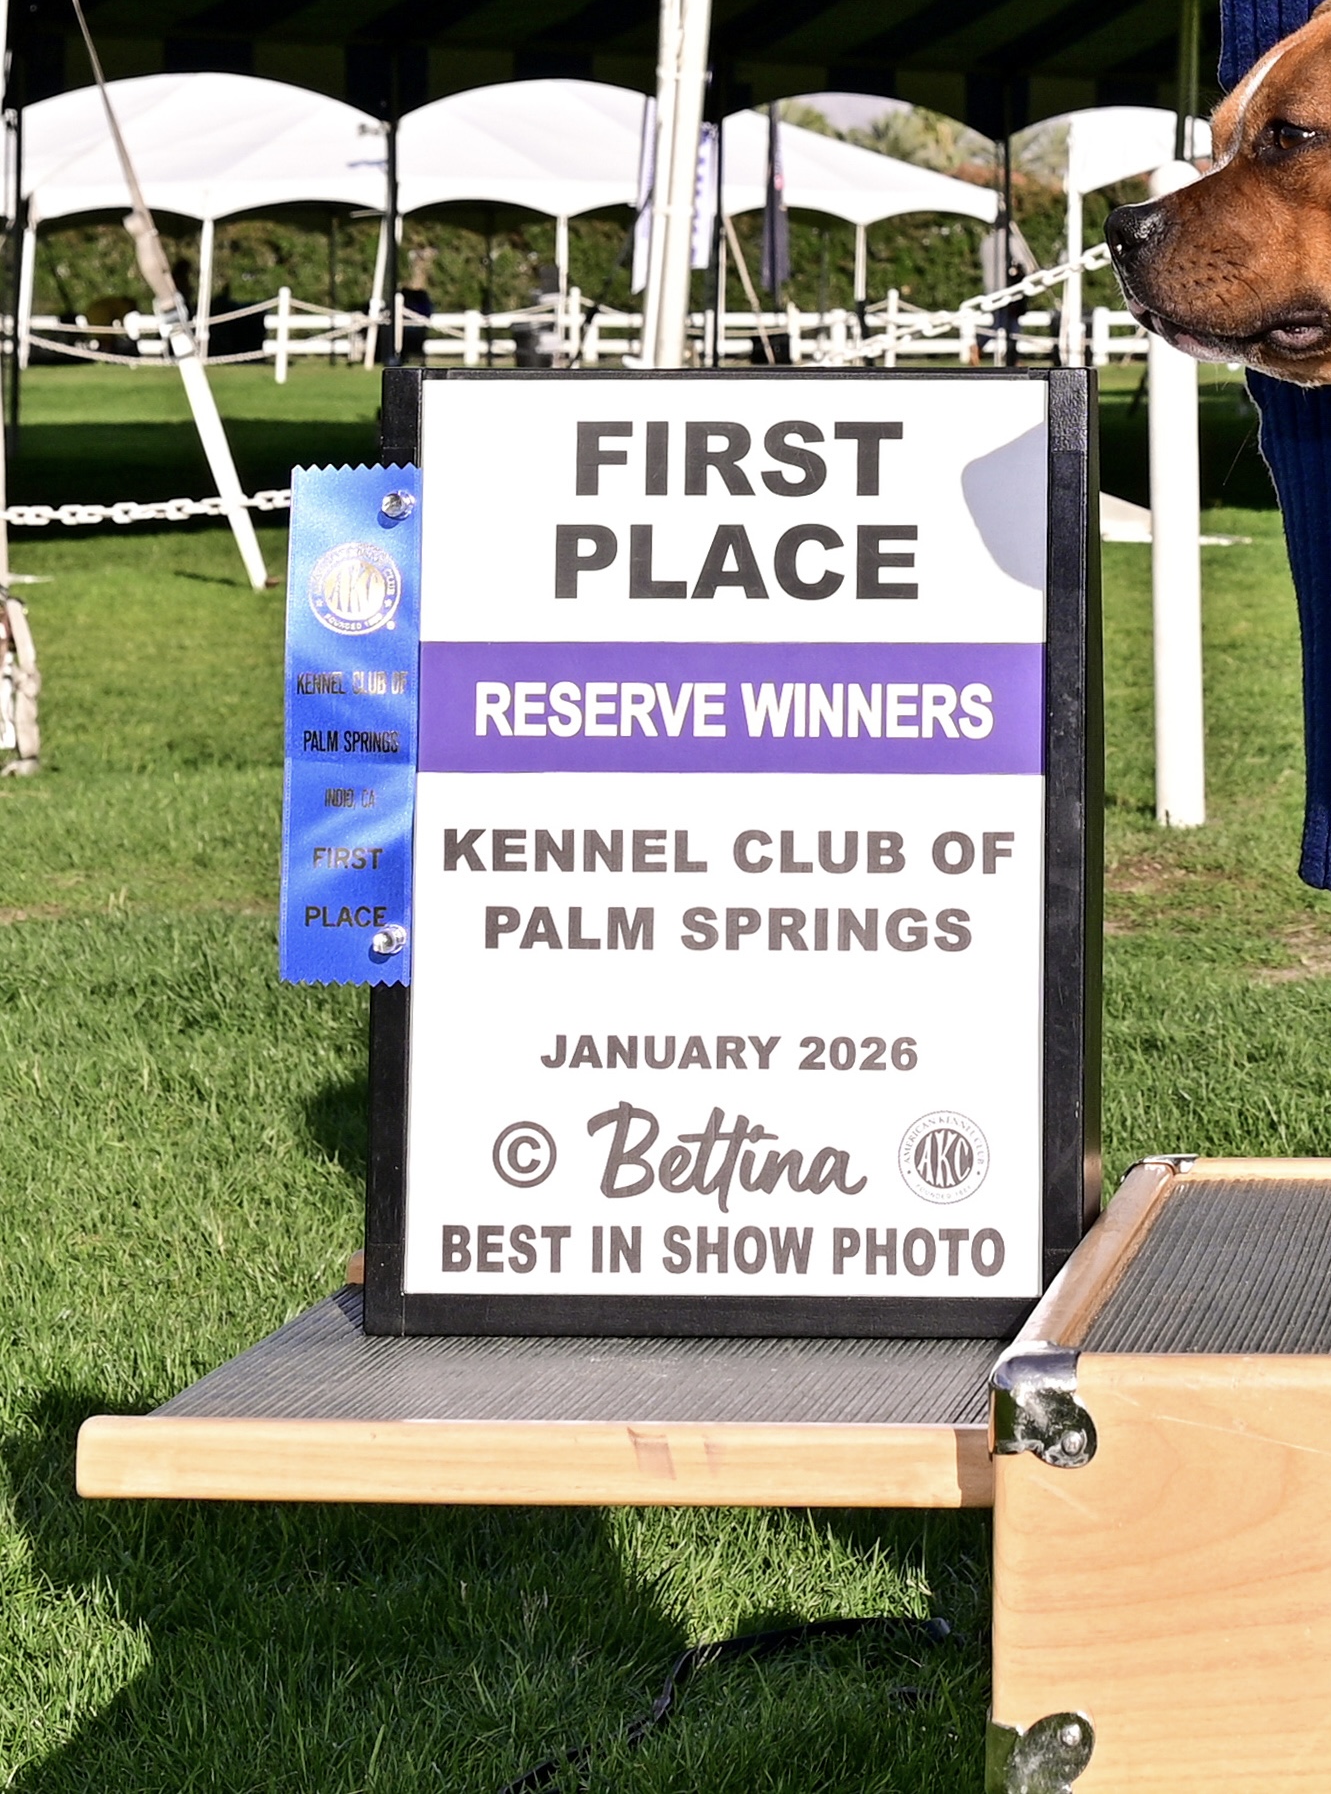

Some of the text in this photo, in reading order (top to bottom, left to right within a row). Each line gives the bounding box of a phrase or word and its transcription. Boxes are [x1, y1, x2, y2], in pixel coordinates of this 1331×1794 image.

[575, 420, 904, 498] FIRST
[554, 523, 919, 601] PLACE
[297, 670, 408, 695] KENNEL CLUB OF
[475, 681, 995, 740] RESERVE WINNERS
[303, 730, 399, 753] PALM SPRINGS
[361, 789, 376, 807] CA
[313, 847, 383, 870] FIRST
[443, 828, 1016, 875] KENNEL CLUB OF
[304, 906, 388, 928] PLACE
[484, 906, 972, 953] PALM SPRINGS
[541, 1035, 918, 1071] JANUARY 2026
[587, 1101, 868, 1214] Bettina
[915, 1129, 973, 1188] AKC
[441, 1224, 1007, 1277] BEST IN SHOW PHOTO
